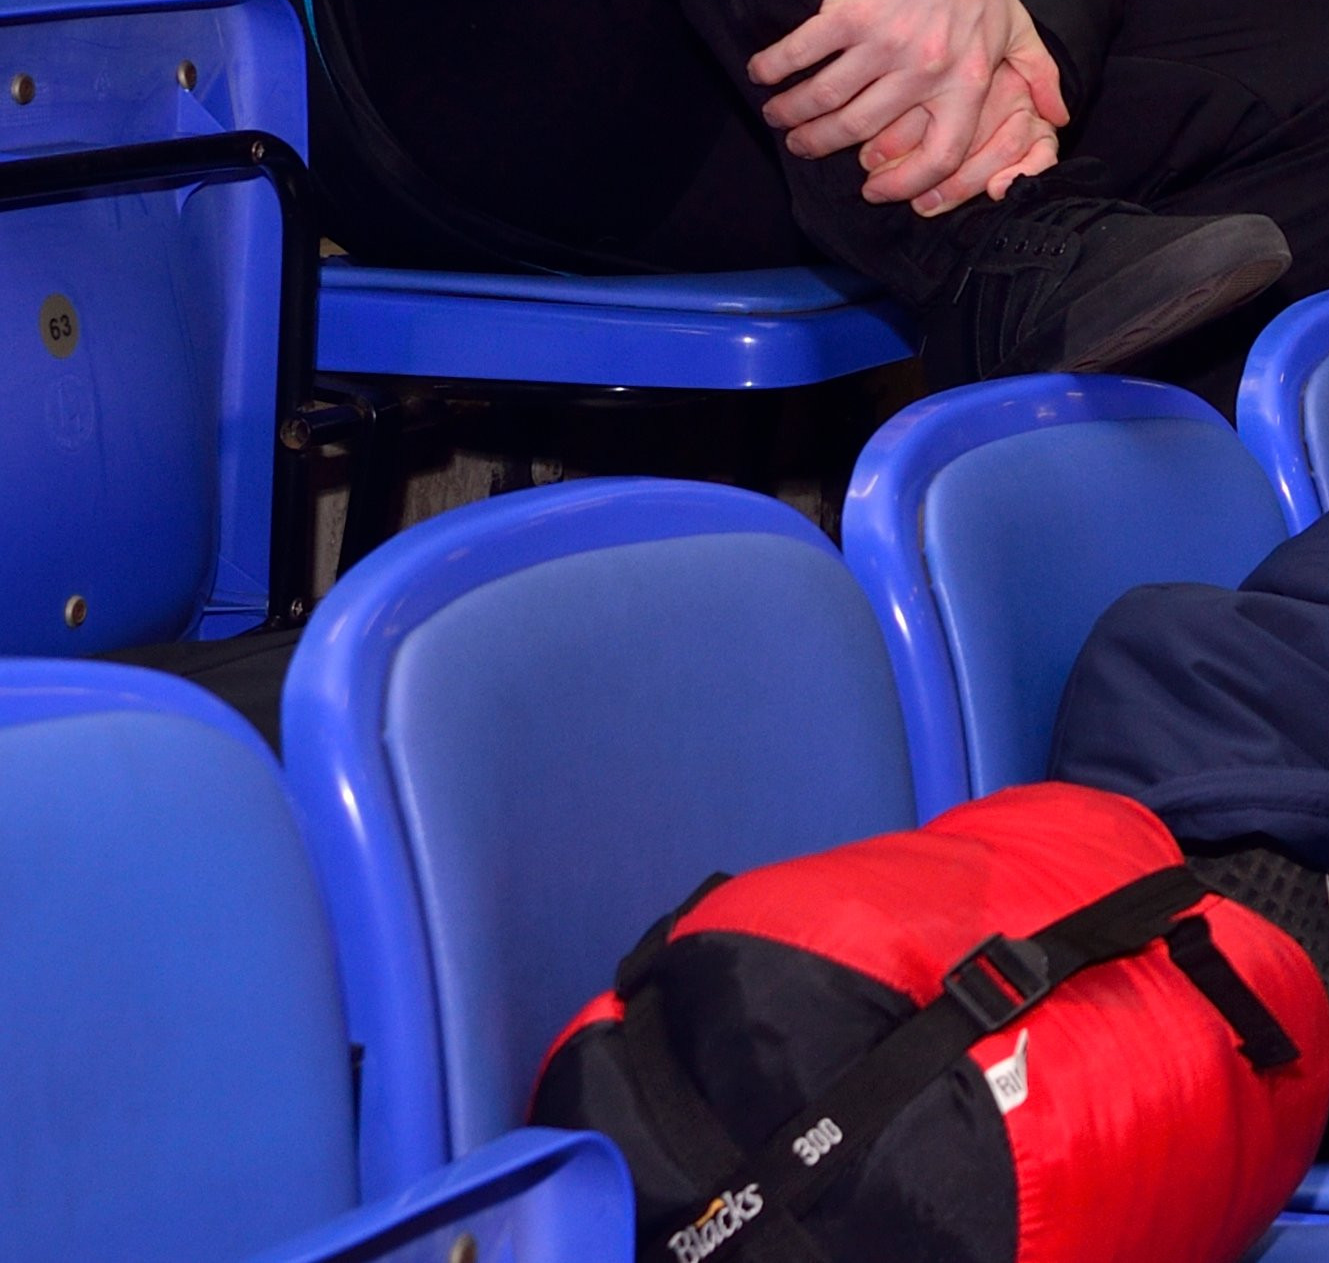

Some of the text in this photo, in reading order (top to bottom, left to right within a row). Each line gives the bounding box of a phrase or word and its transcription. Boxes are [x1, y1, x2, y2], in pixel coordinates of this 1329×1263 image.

[49, 314, 72, 341] 63
[792, 1117, 843, 1167] 300
[666, 1182, 764, 1263] Blacks
